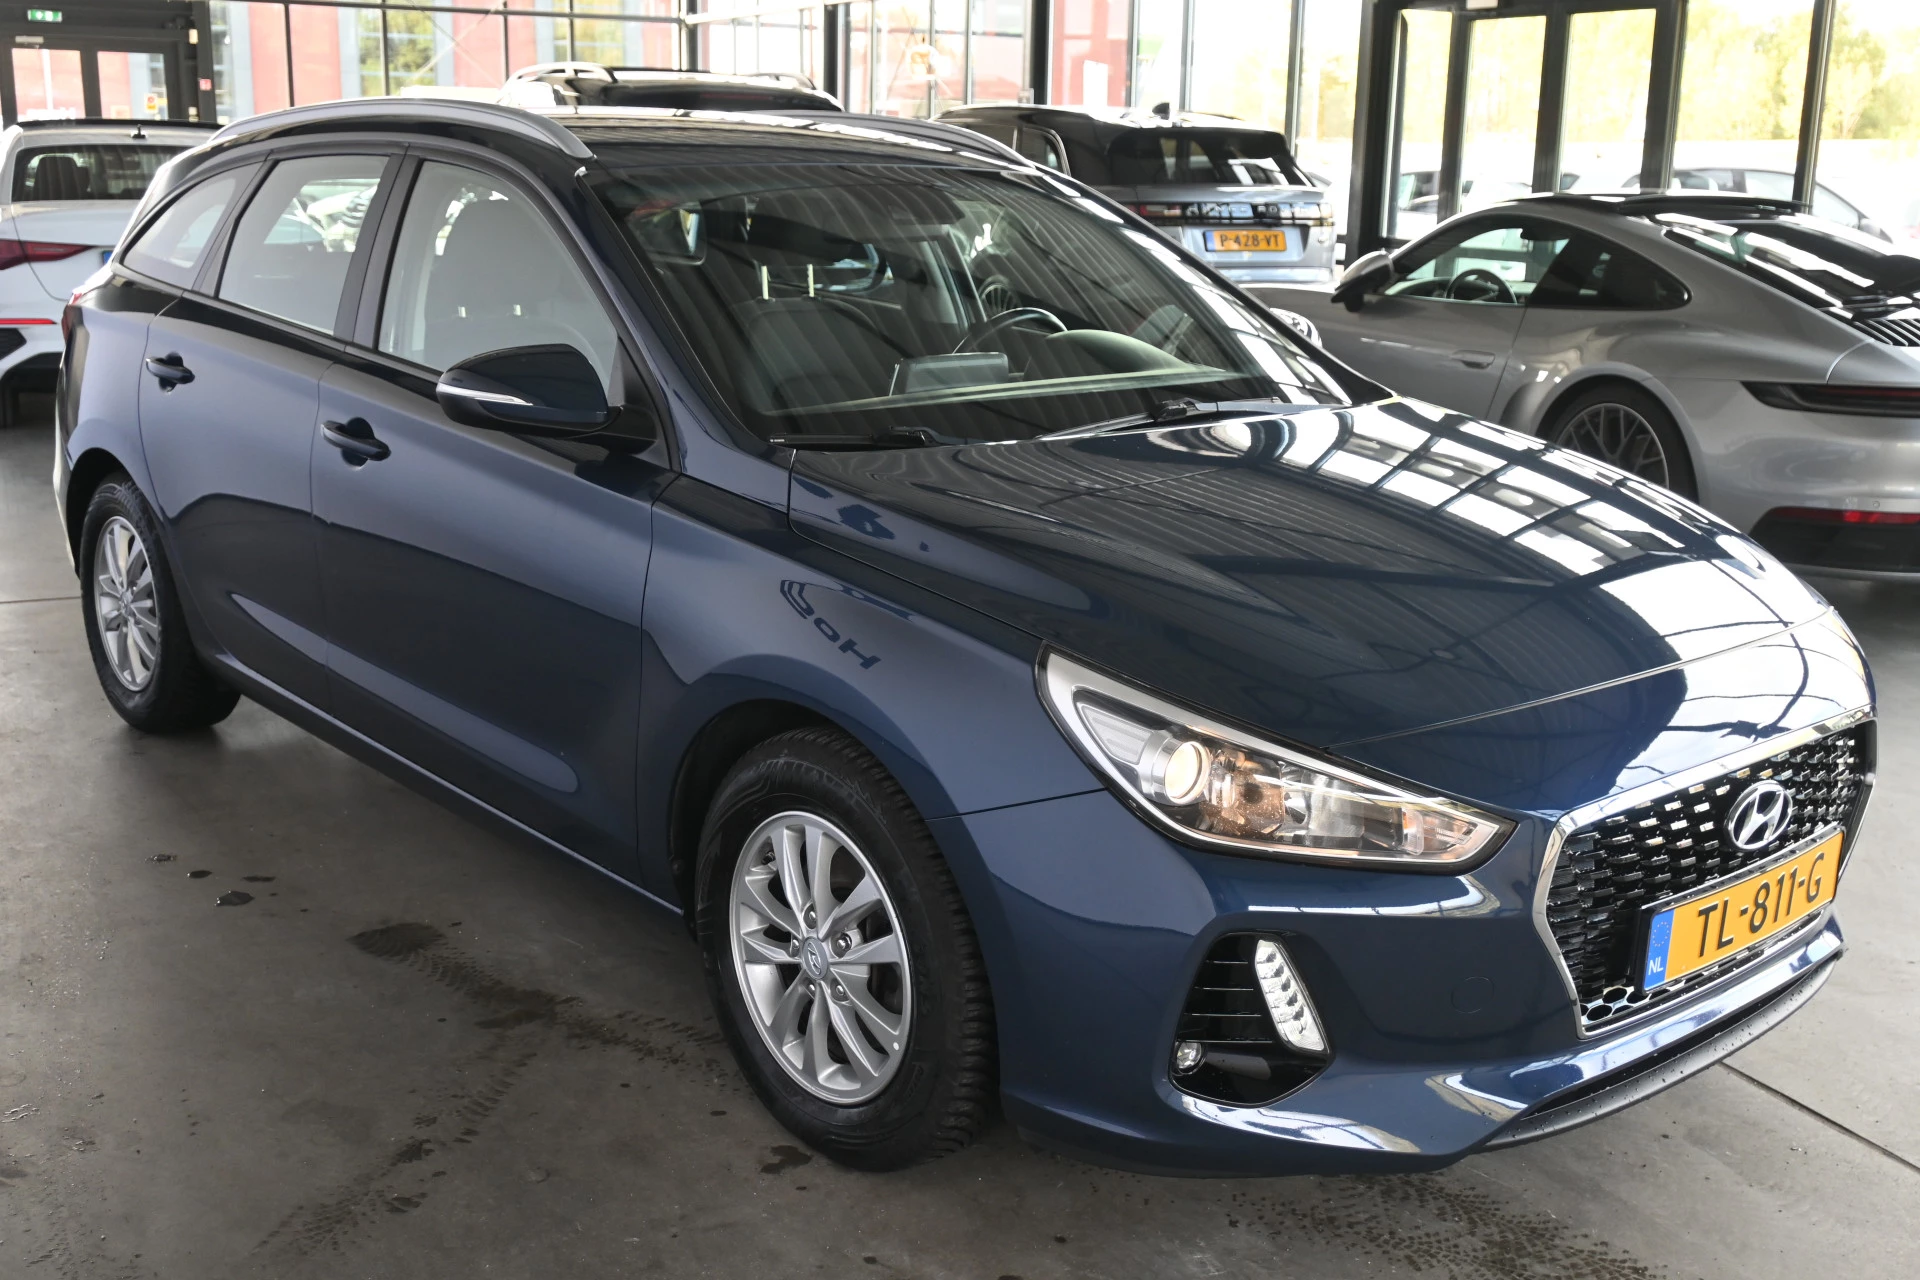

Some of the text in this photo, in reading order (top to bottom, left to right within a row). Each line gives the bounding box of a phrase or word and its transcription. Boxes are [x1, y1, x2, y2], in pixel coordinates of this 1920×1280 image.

[1220, 233, 1280, 247] P-428-VT
[1698, 852, 1825, 958] TL-811-G
[1648, 956, 1664, 976] NL
